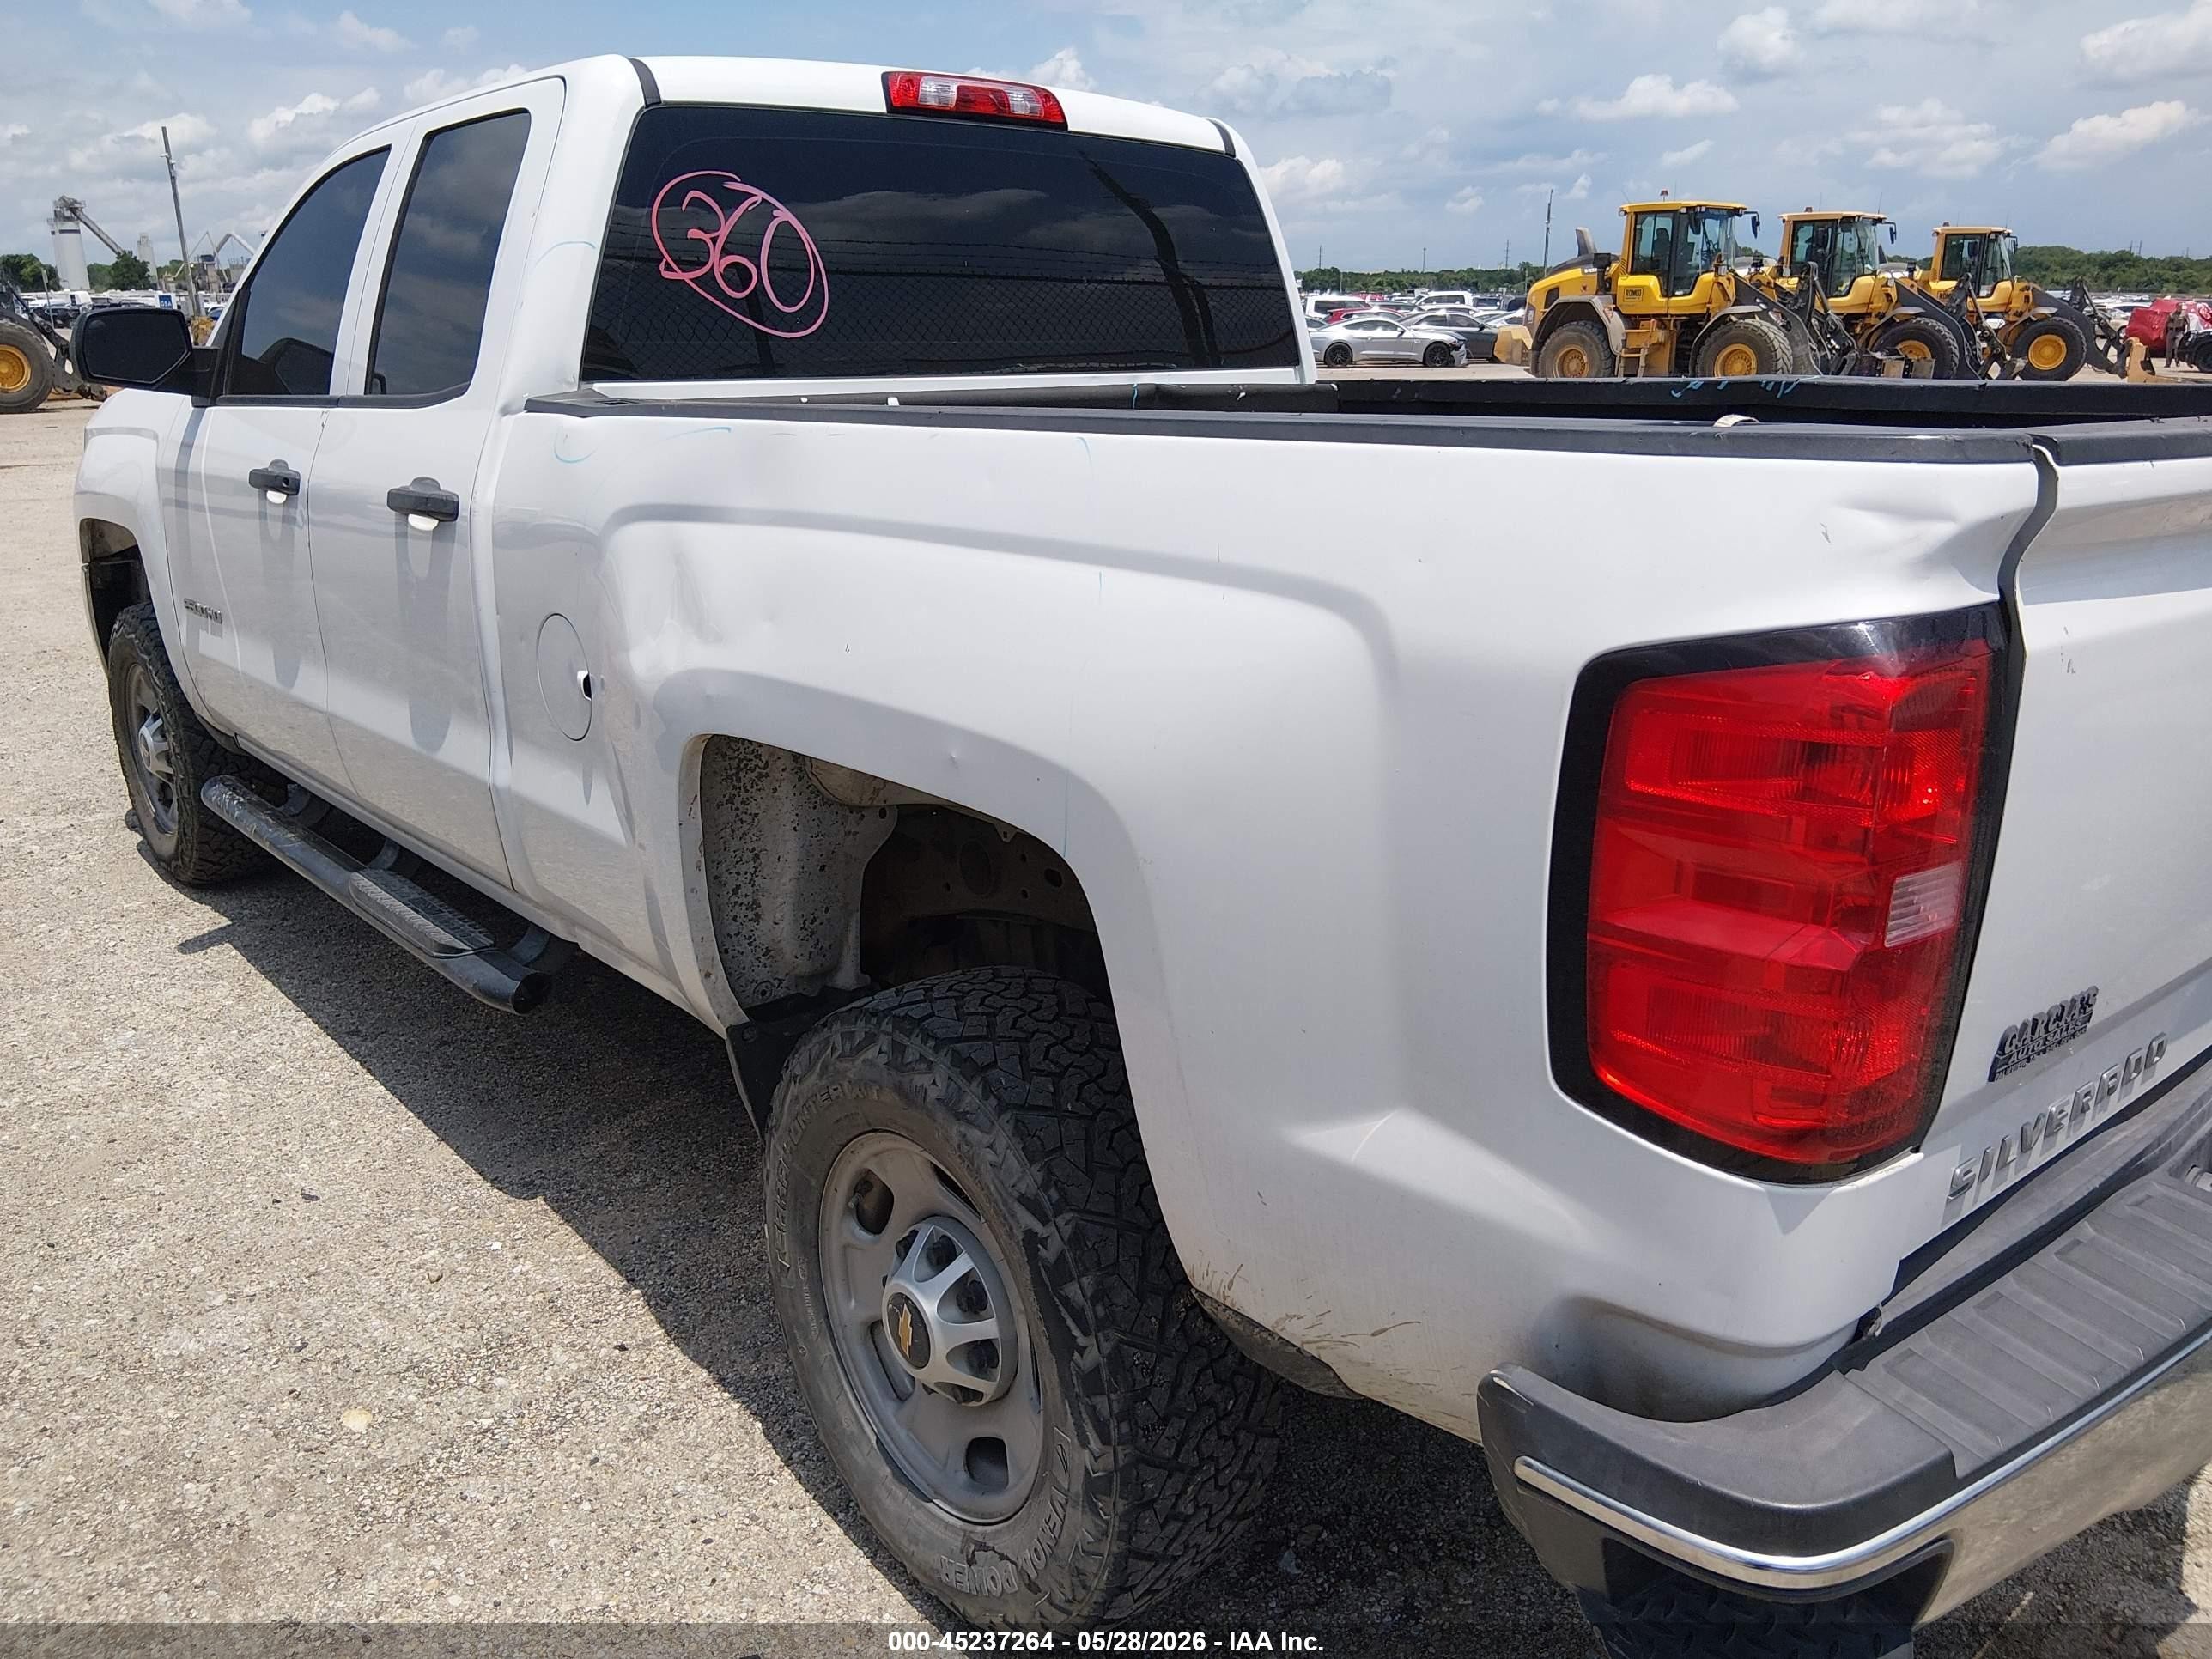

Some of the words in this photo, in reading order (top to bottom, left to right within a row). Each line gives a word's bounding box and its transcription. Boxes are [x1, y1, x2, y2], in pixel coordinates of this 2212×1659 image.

[659, 190, 815, 313] 360
[2008, 1041, 2042, 1065] AUTO
[2045, 1018, 2083, 1043] SALES
[1947, 1031, 2169, 1200] SILVERADO
[939, 1553, 1019, 1598] POWER
